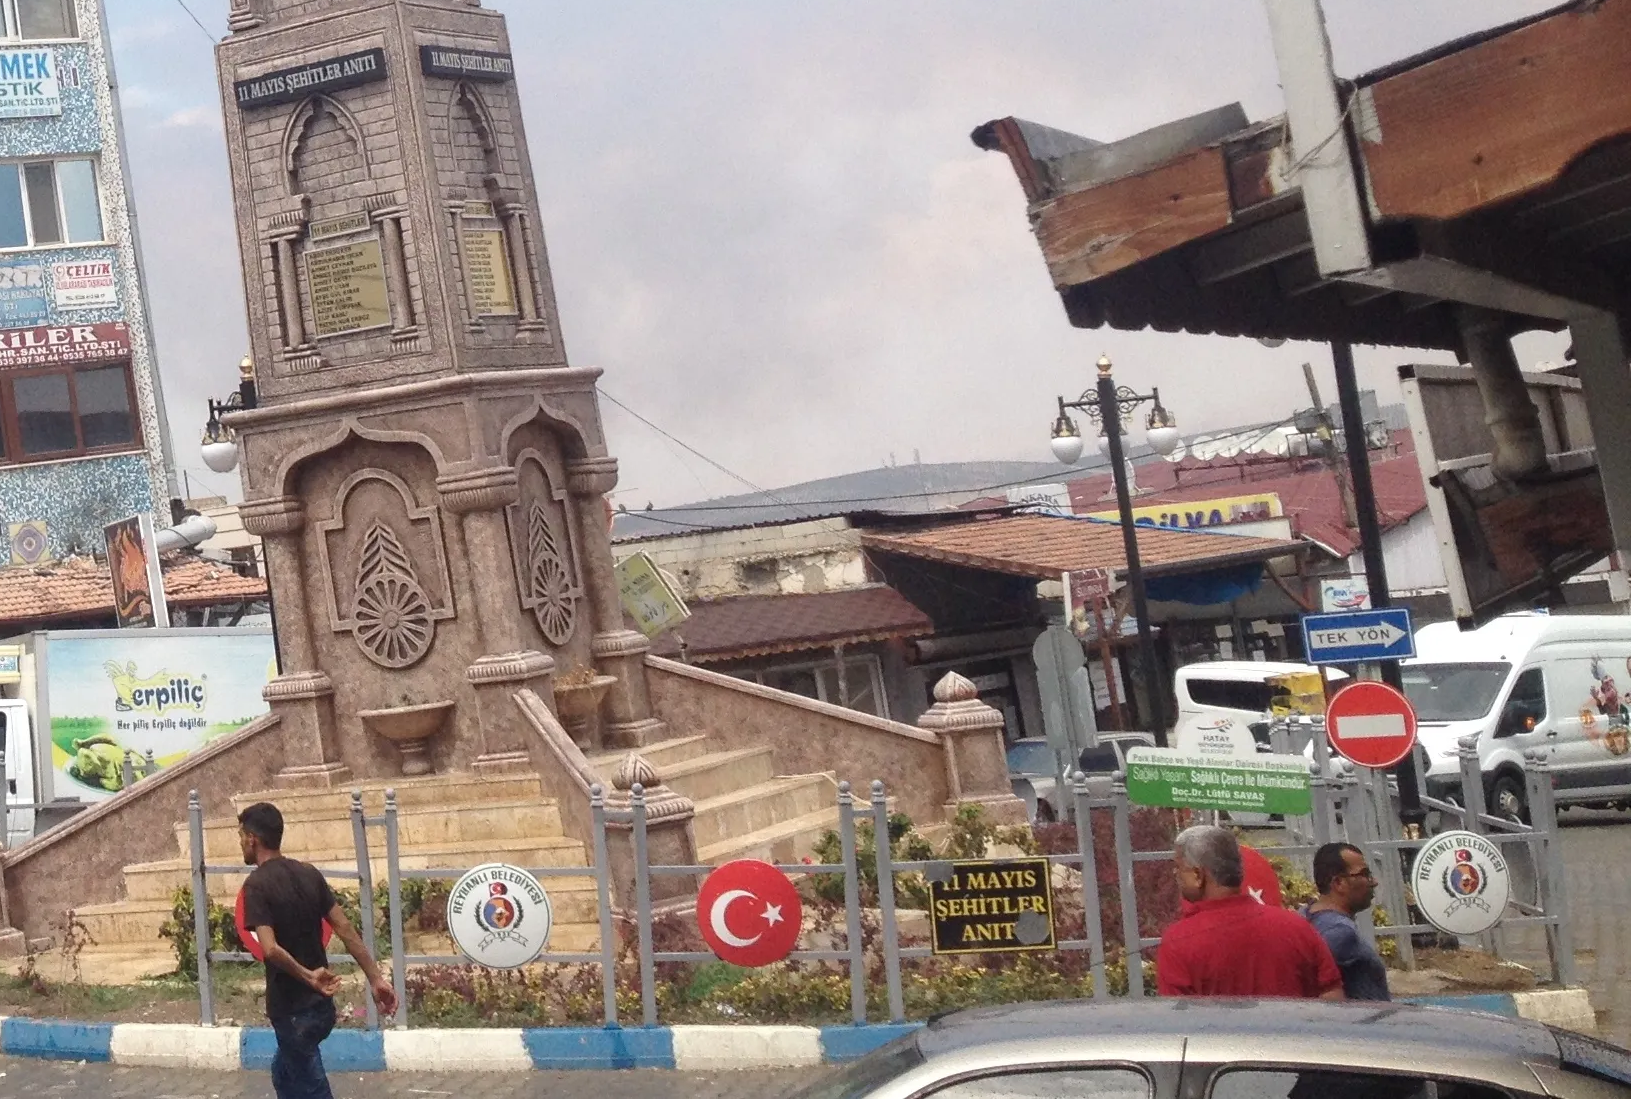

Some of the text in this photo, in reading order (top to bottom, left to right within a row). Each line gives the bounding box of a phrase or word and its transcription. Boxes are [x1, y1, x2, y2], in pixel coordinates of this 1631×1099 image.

[438, 52, 461, 68] MAYIS
[461, 52, 492, 72] ŞEHİTLER
[493, 56, 512, 74] ANITI
[237, 54, 377, 102] 11 MAYIS ŞEHİTLER ANITI
[1317, 628, 1390, 644] TEK YÖN
[133, 678, 204, 711] erpiliç
[117, 720, 130, 730] Her
[1203, 734, 1230, 743] HATAY
[1206, 757, 1234, 767] Alanlar
[1221, 771, 1244, 788] Çevre
[1206, 788, 1231, 798] Lütfü
[1233, 791, 1265, 802] SAVAŞ
[1419, 837, 1506, 881] REYHANLI BELEDİYESİ
[942, 870, 1037, 891] 11 MAYIS
[452, 870, 544, 915] REYHANLI BELEDİYESİ
[935, 893, 1047, 922] ŞEHİTLER
[961, 922, 1017, 942] ANIT
